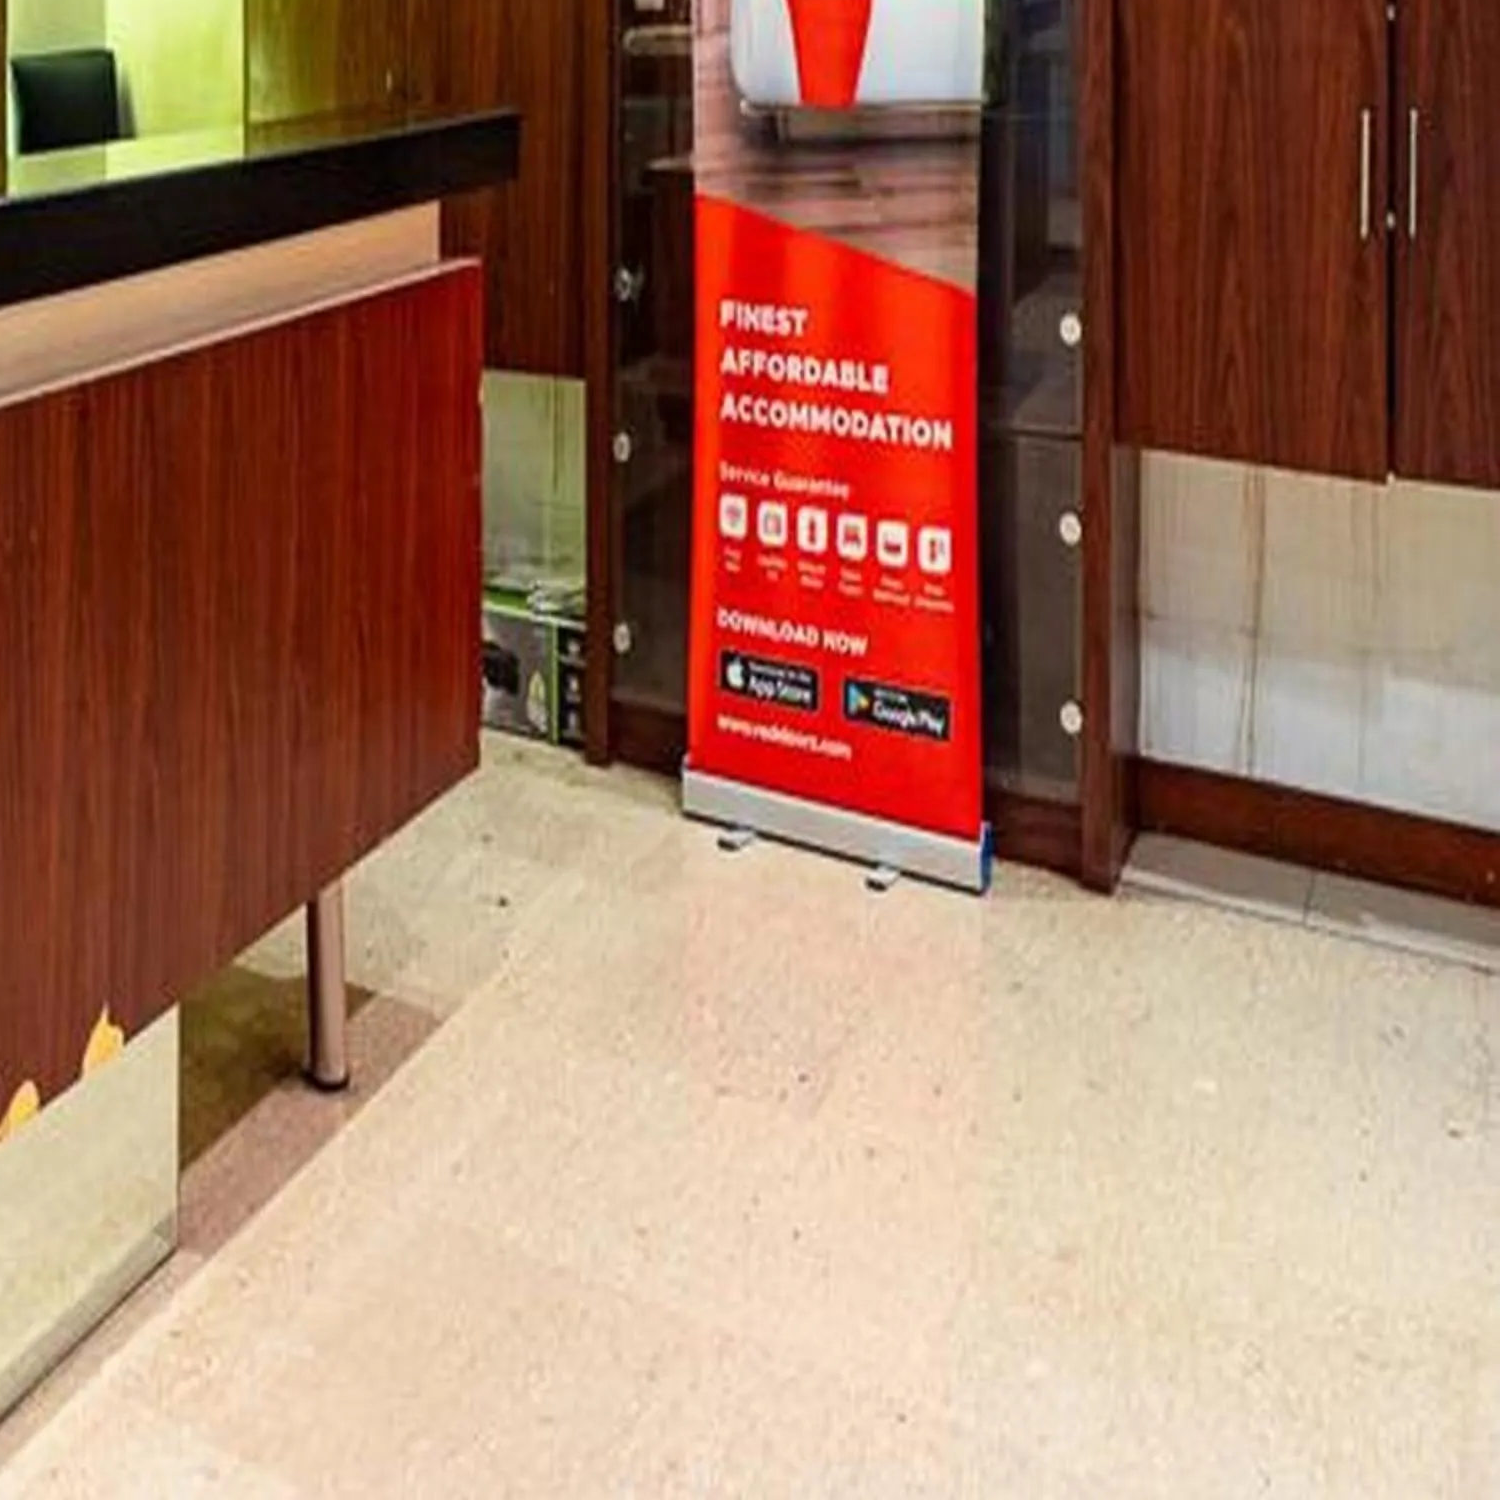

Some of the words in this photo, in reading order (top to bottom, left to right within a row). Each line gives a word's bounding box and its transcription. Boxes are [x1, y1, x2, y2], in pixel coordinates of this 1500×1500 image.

[719, 299, 808, 337] FINEST
[720, 347, 889, 395] AFFORDABLE
[720, 392, 953, 450] ACCOMMODATION
[717, 607, 819, 648] DOWNLOAD
[823, 628, 868, 656] NOW
